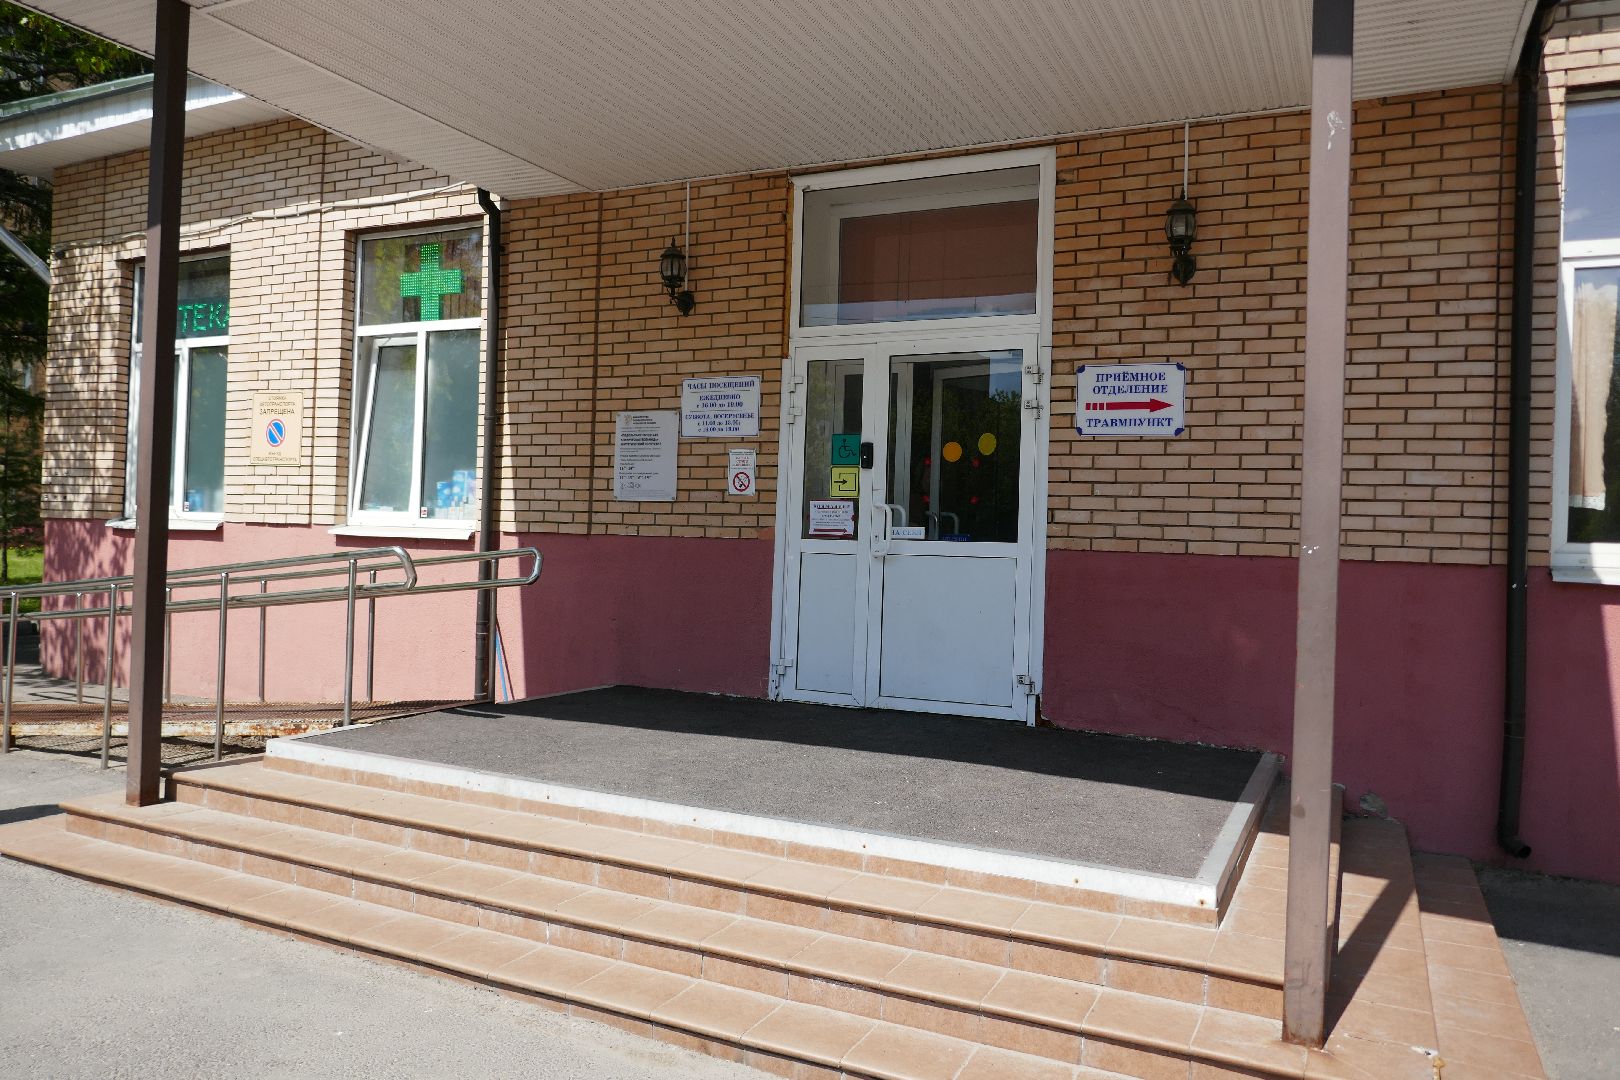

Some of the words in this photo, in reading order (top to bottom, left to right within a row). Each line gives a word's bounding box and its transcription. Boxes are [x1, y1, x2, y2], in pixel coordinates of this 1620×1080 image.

[1095, 371, 1166, 382] ПРИЁМНОЕ
[687, 382, 707, 390] ЧАСЫ
[709, 380, 755, 389] ПОСЕЩЕНИЙ
[1092, 384, 1168, 396] ОТДЕЛЕНИЕ
[1085, 417, 1173, 428] ТРАВМПУНКТ
